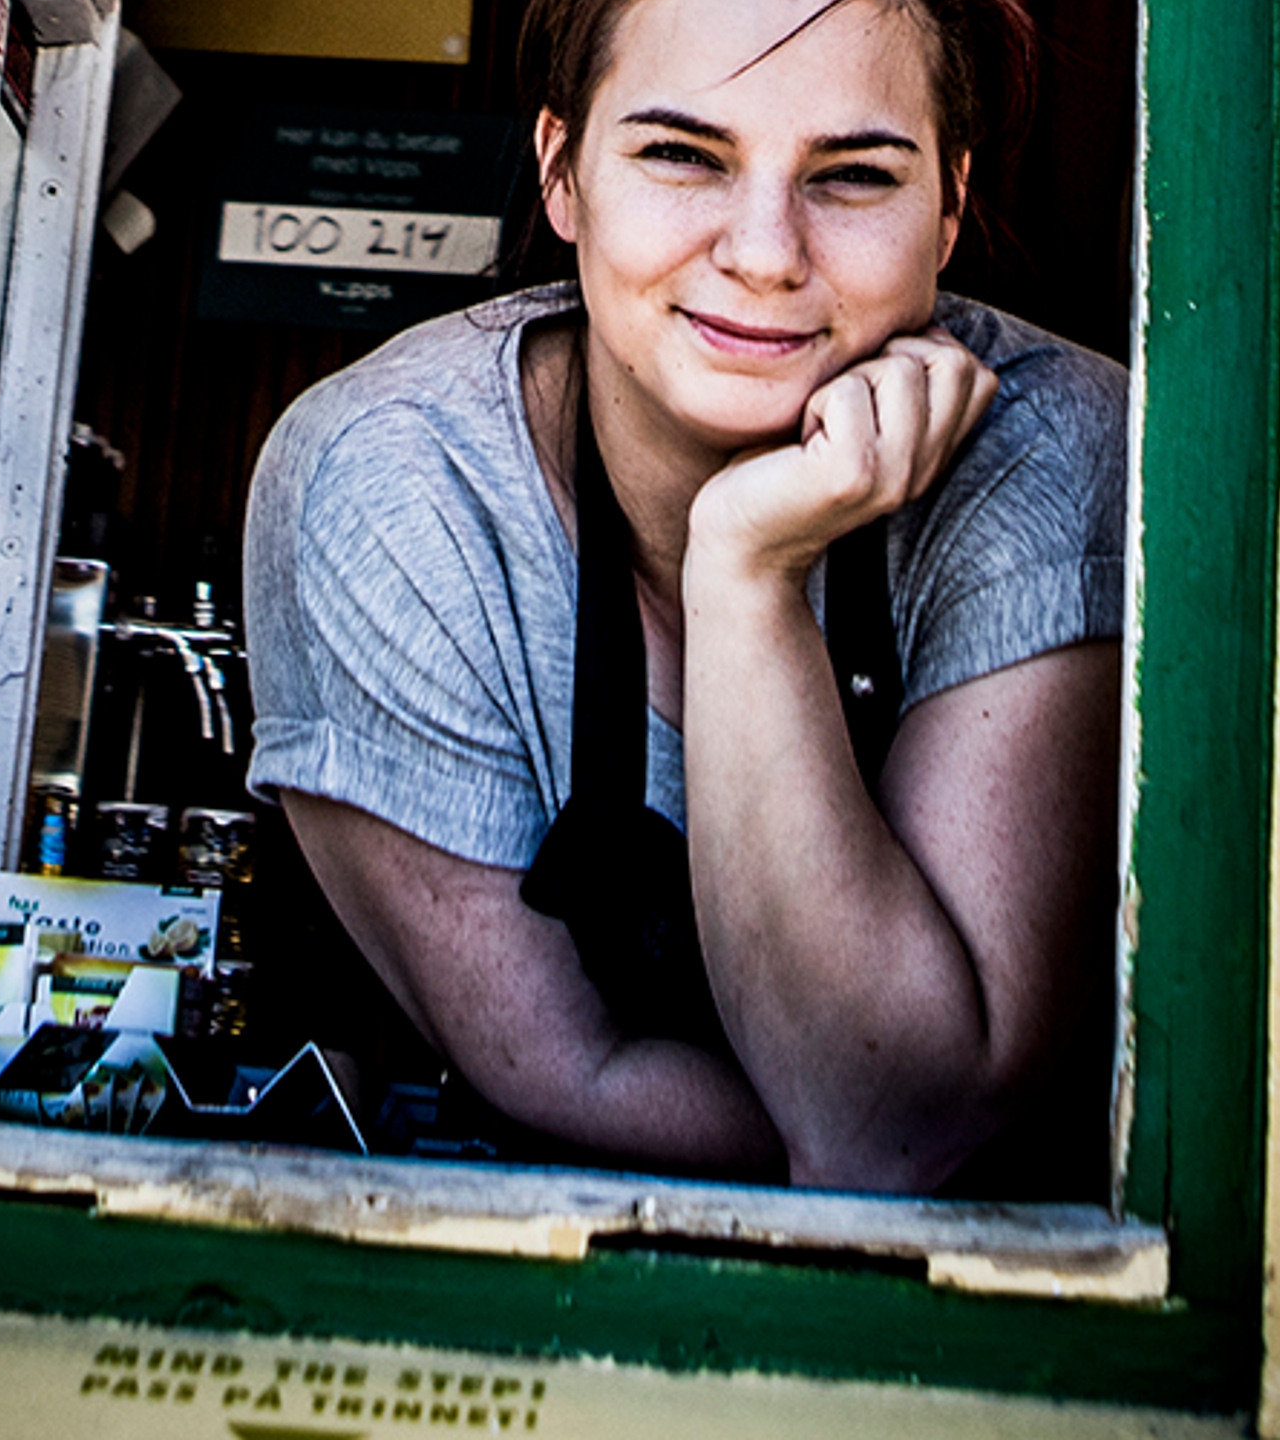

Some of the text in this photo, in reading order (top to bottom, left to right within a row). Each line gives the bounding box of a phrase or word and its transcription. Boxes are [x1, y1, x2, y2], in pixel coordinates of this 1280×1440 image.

[255, 208, 342, 255] 100
[80, 1372, 195, 1404] PASS
[93, 1341, 245, 1378] MIND
[274, 1357, 368, 1389] THE
